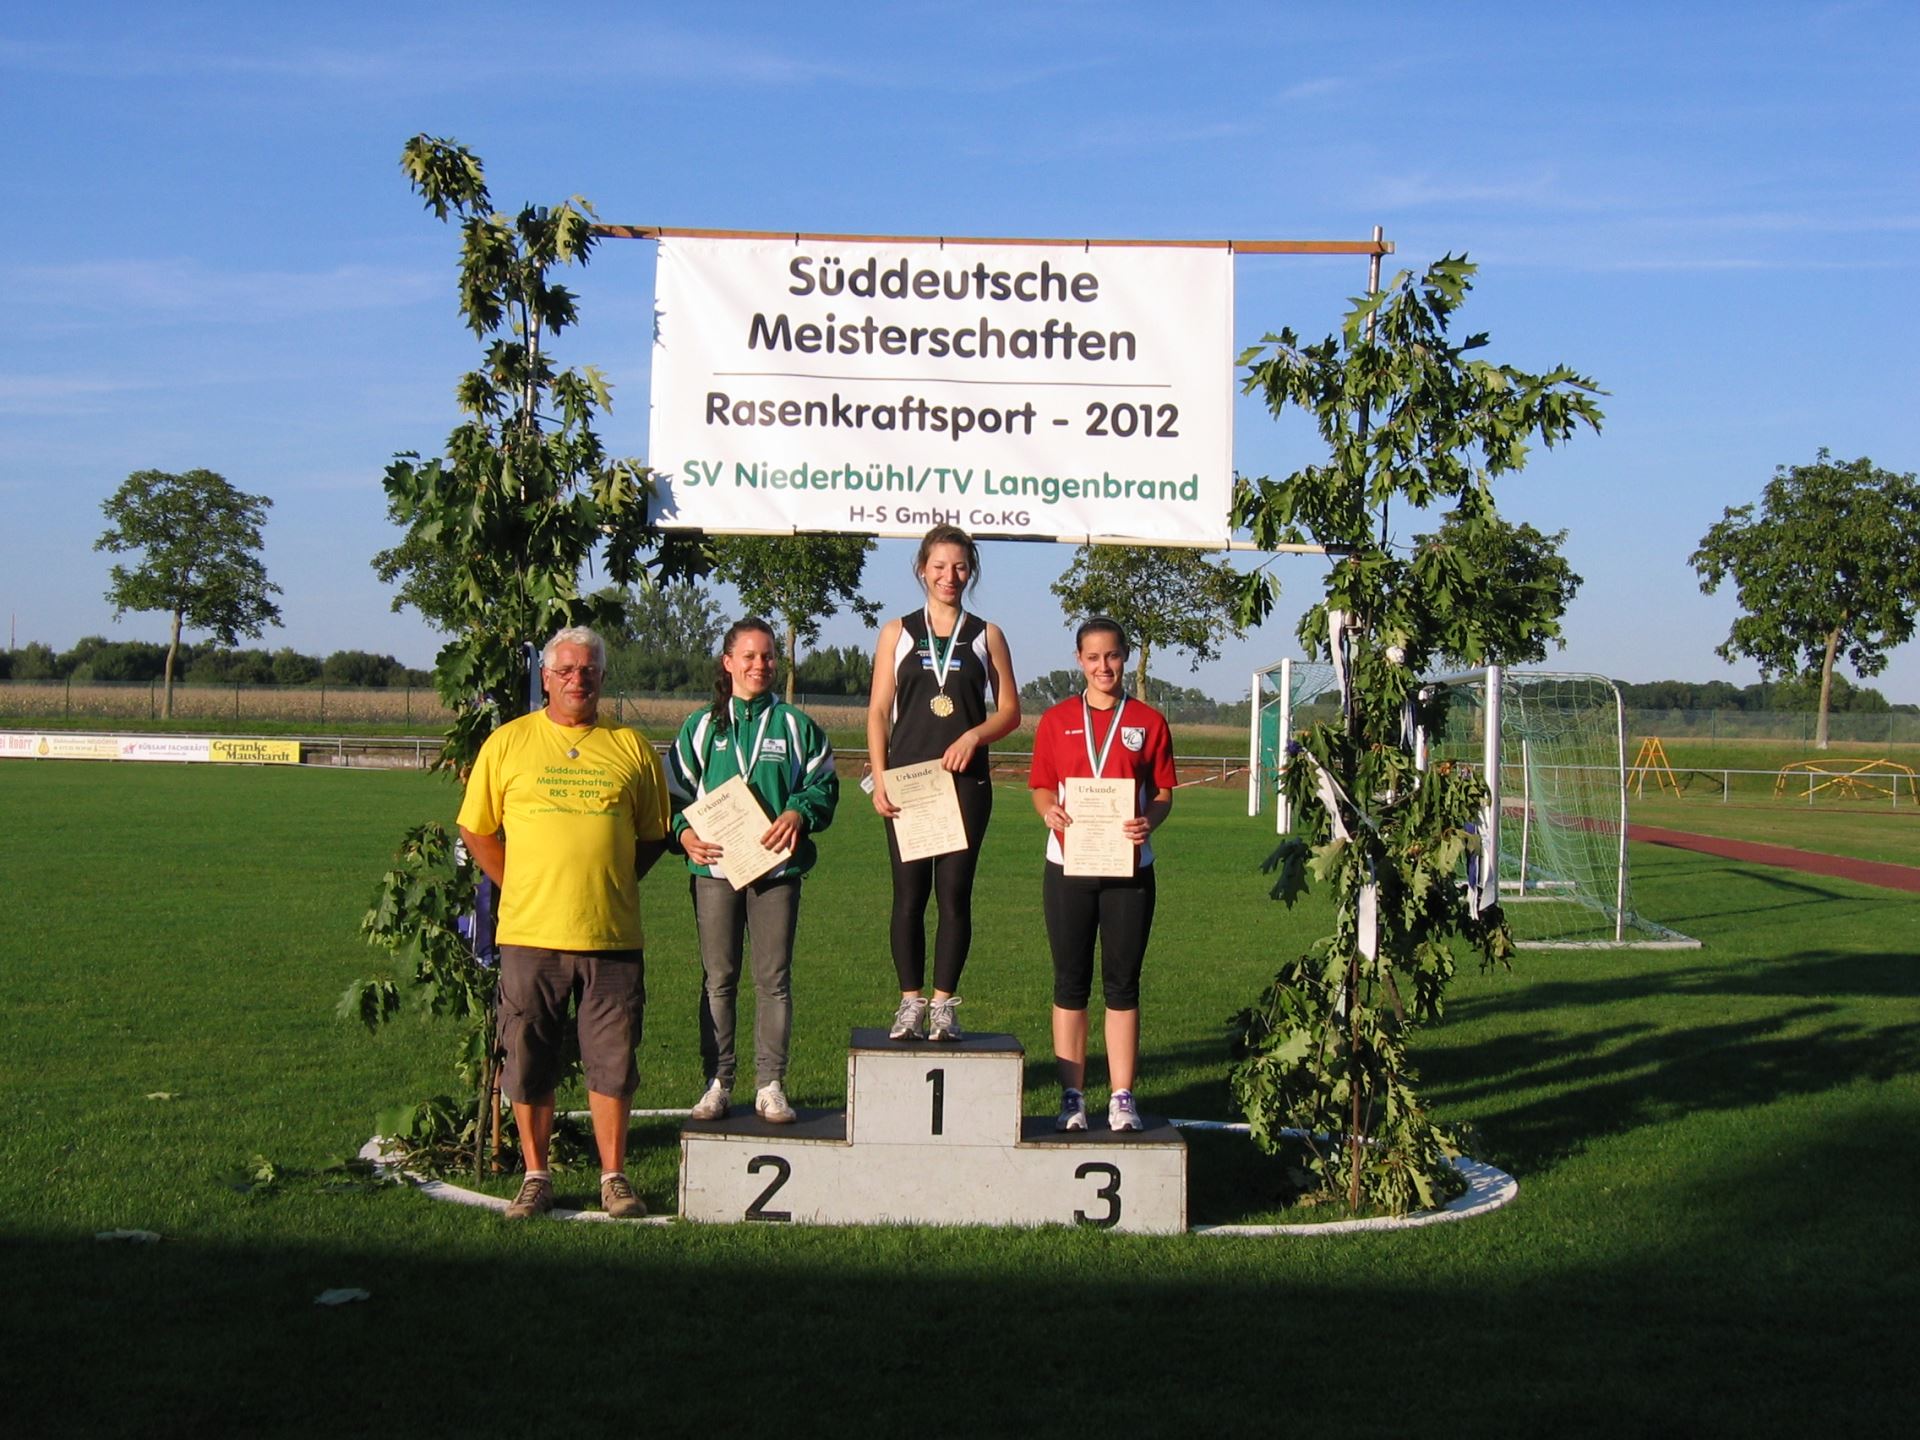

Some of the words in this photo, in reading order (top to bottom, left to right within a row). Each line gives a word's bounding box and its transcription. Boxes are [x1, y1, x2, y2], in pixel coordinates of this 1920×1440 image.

[789, 255, 1100, 303] Süddeutsche
[748, 312, 1137, 361] Meisterschaften
[705, 391, 1037, 441] Rasenkraftsport
[1085, 402, 1180, 438] 2012
[682, 460, 724, 487] SV
[735, 462, 974, 495] Niederbühl/TV
[984, 469, 1199, 504] Langenbrand
[849, 505, 888, 523] H-S
[895, 506, 961, 525] GmbH
[969, 508, 1031, 527] Co.KG
[536, 777, 614, 788] Meisterschaften
[543, 765, 606, 777] Süddeutsche
[896, 767, 934, 783] Urkunde
[549, 788, 569, 798] RKS
[579, 789, 601, 799] 2012
[697, 791, 731, 816] Urkunde
[1078, 785, 1118, 794] Urkunde
[925, 1068, 946, 1136] 1
[744, 1154, 793, 1222] 2
[1073, 1161, 1122, 1229] 3
